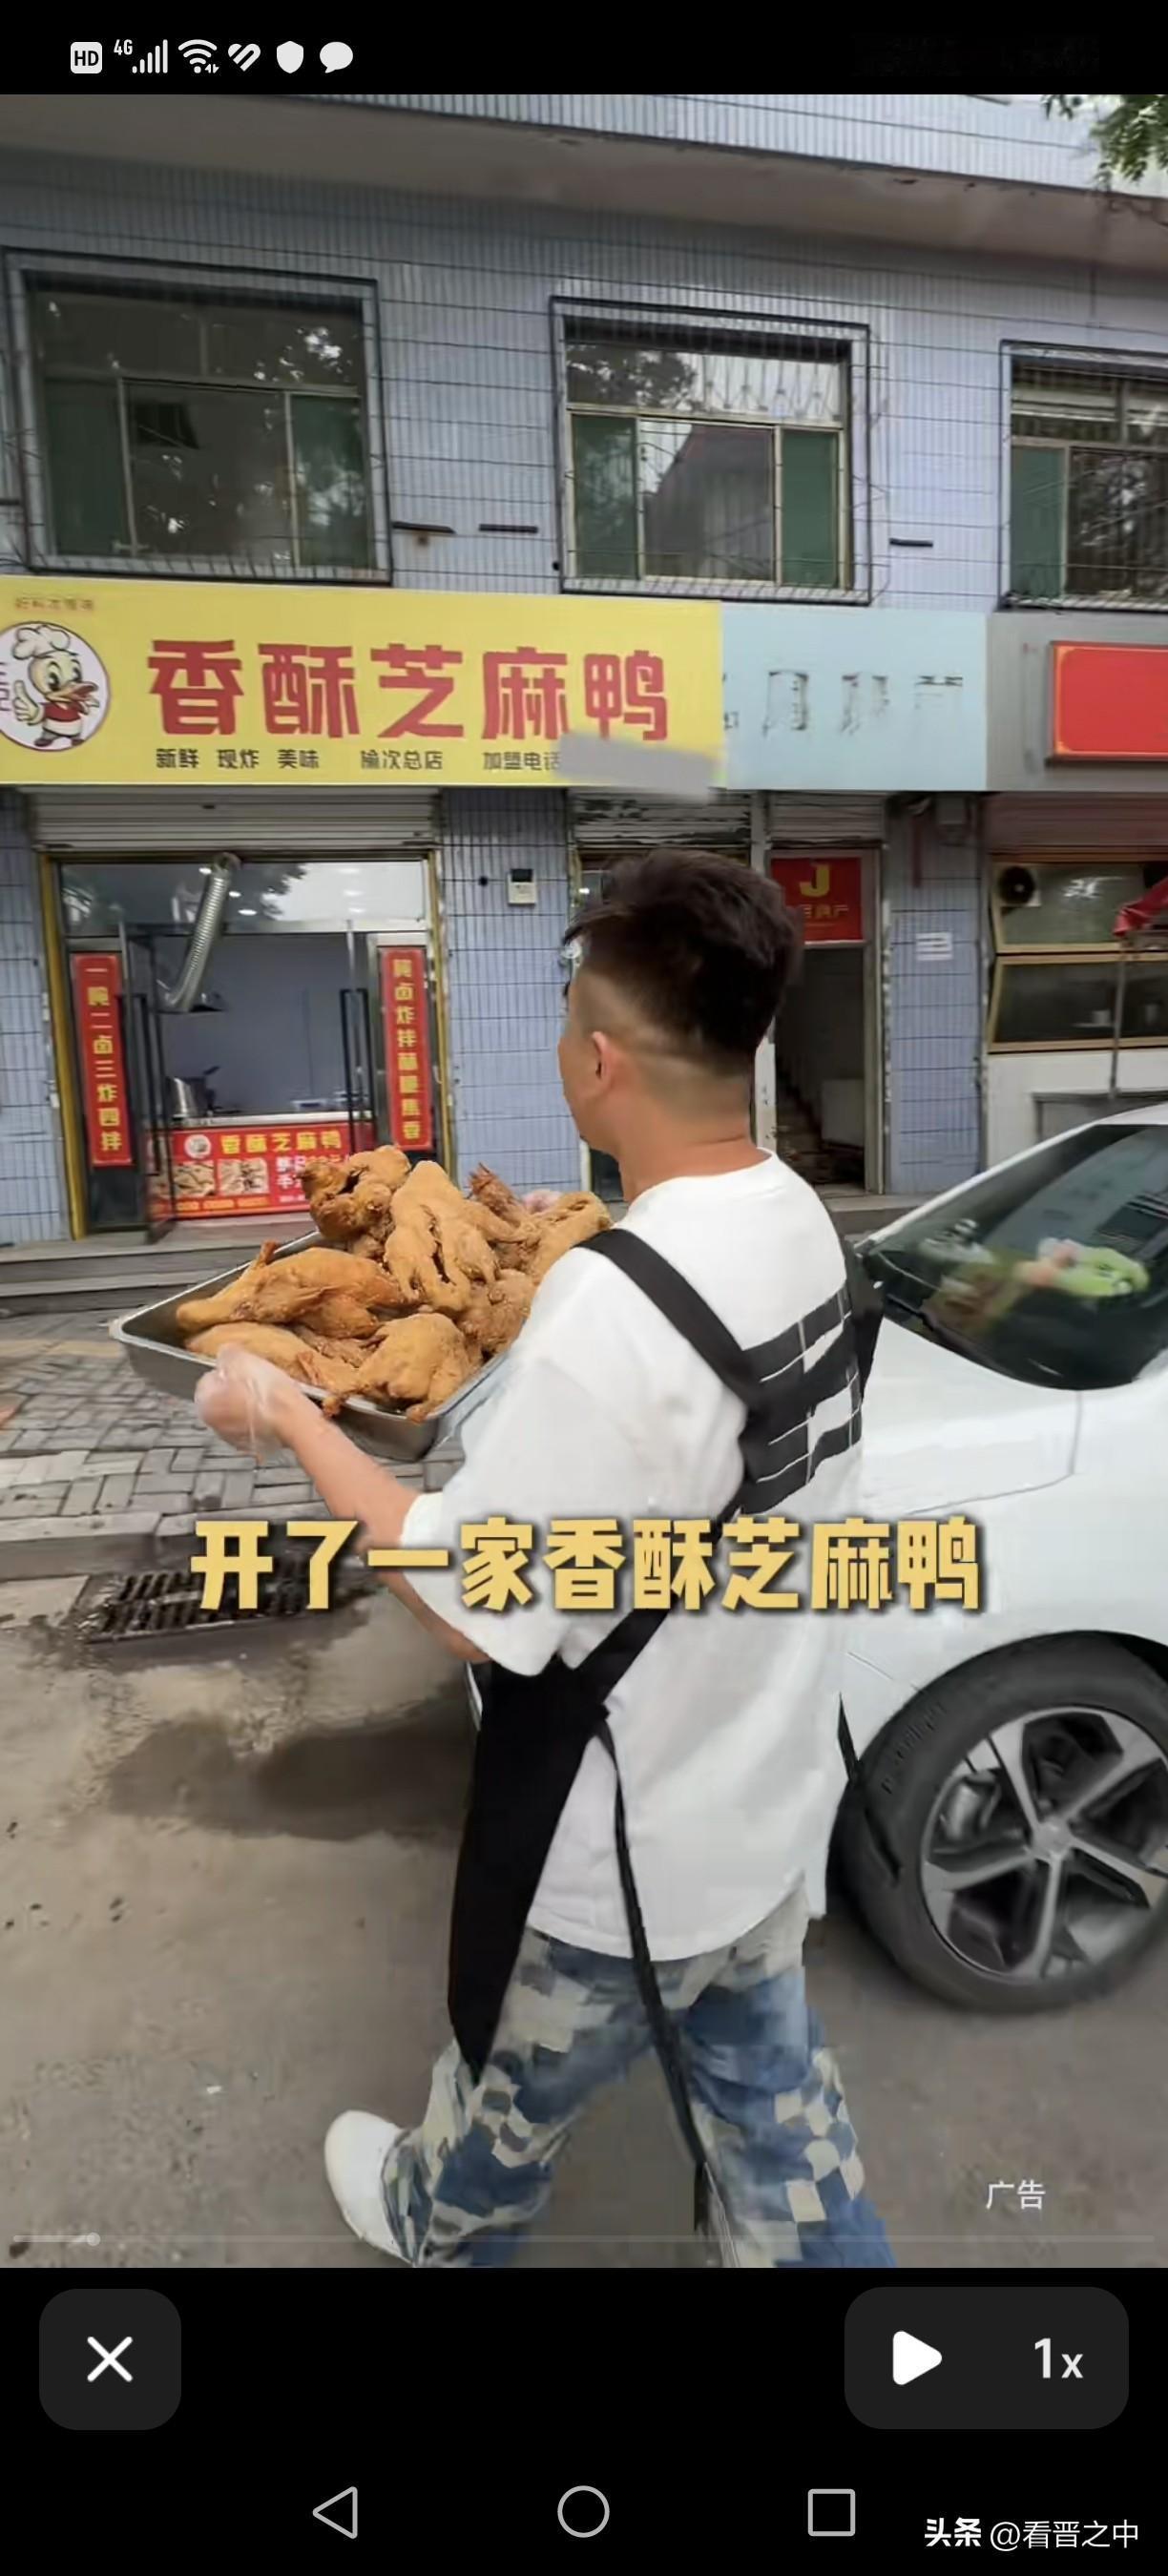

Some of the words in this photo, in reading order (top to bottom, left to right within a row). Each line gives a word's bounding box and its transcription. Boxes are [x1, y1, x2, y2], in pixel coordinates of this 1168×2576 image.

[147, 638, 669, 741] 香酥芝麻鸭
[155, 749, 199, 769] 新鲜
[217, 749, 260, 769] 现炸
[277, 749, 320, 769] 美味
[800, 863, 830, 897] J
